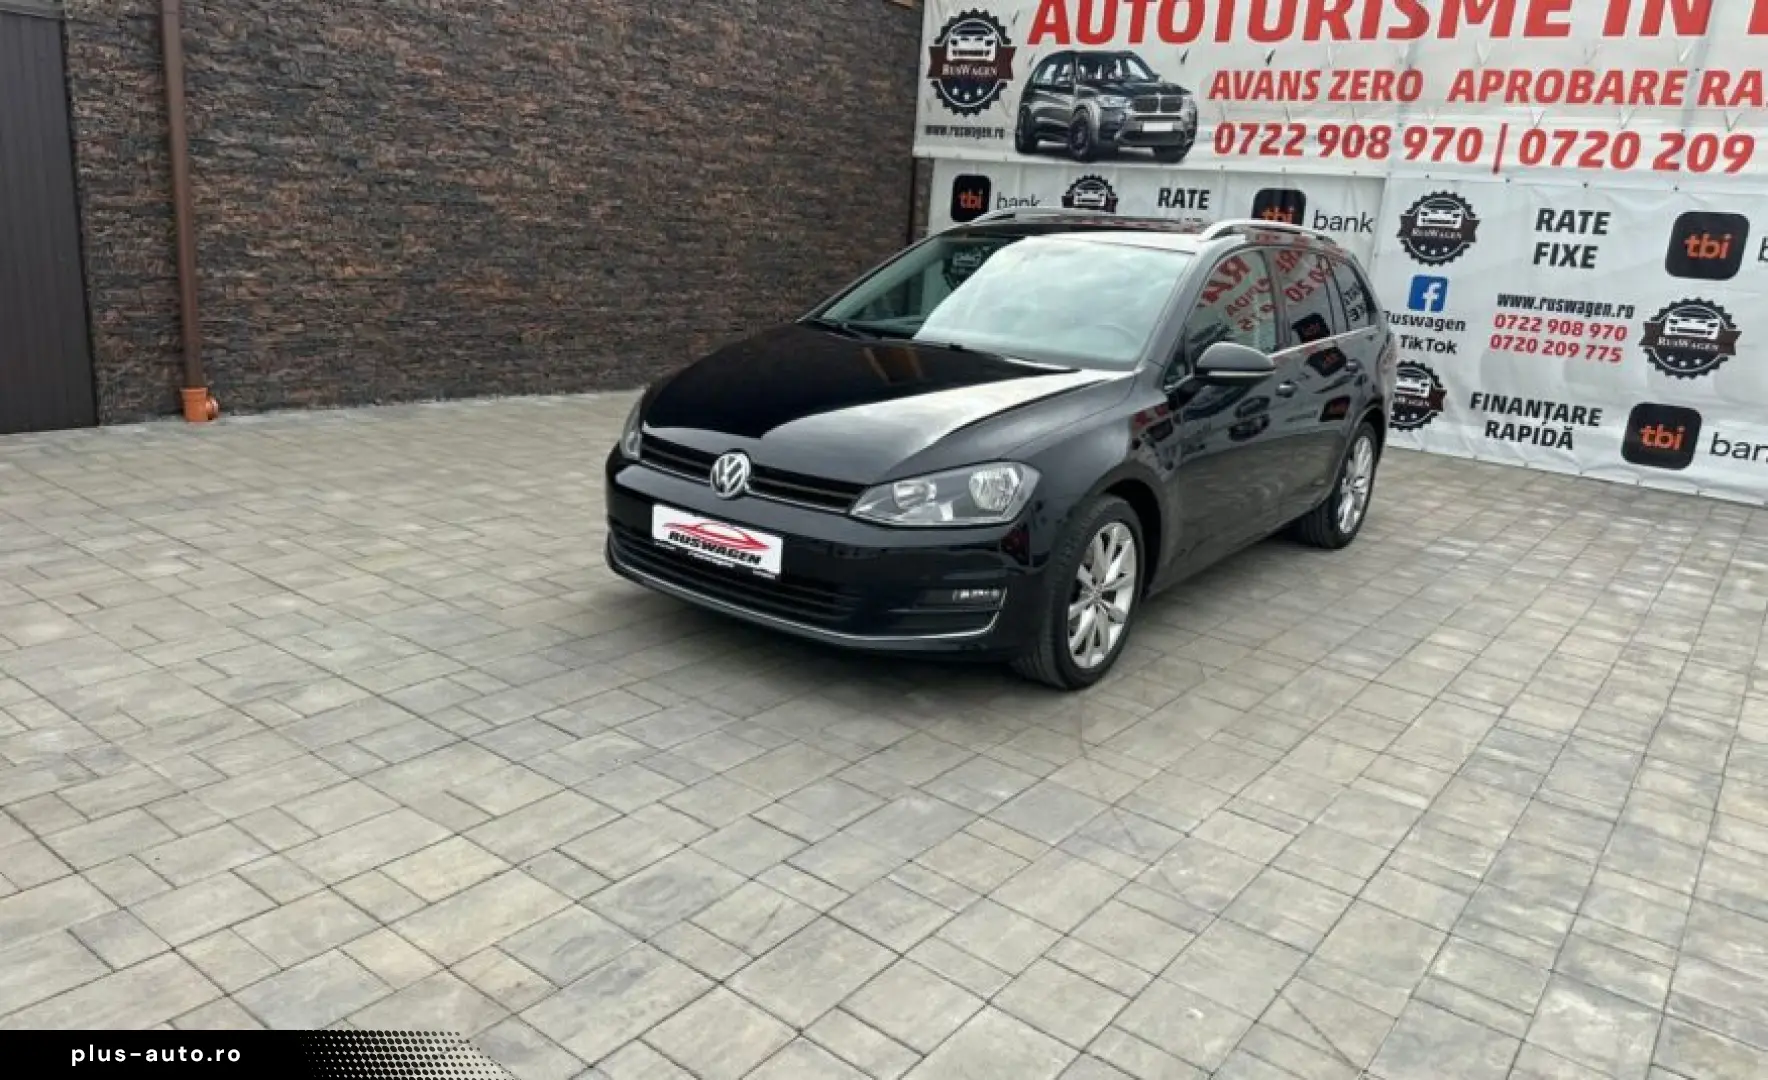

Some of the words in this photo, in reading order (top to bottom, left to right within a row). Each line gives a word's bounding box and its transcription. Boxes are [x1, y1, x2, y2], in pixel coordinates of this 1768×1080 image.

[1028, 0, 1571, 45] AUTOTURISME
[1208, 70, 1320, 101] AVANS
[1328, 70, 1423, 103] ZERO
[1448, 69, 1688, 106] APROBARE
[1697, 70, 1768, 107] RA
[1214, 122, 1307, 155] 0722
[1317, 124, 1392, 159] 908
[1403, 126, 1484, 163] 970
[1519, 128, 1641, 170] 0720
[1653, 132, 1756, 173] 209
[1158, 187, 1211, 211] RATE
[1313, 210, 1374, 233] bank
[1535, 208, 1611, 235] RATE
[1533, 242, 1599, 269] FIXE
[1684, 233, 1732, 259] tbi
[1497, 293, 1636, 319] www.ruswagen.ro
[1494, 314, 1543, 333] 0722
[1548, 318, 1584, 337] 908
[1590, 322, 1628, 342] 970
[1490, 334, 1538, 354] 0720
[1541, 340, 1580, 358] 209
[1586, 344, 1624, 363] 775
[1640, 424, 1686, 450] tbi
